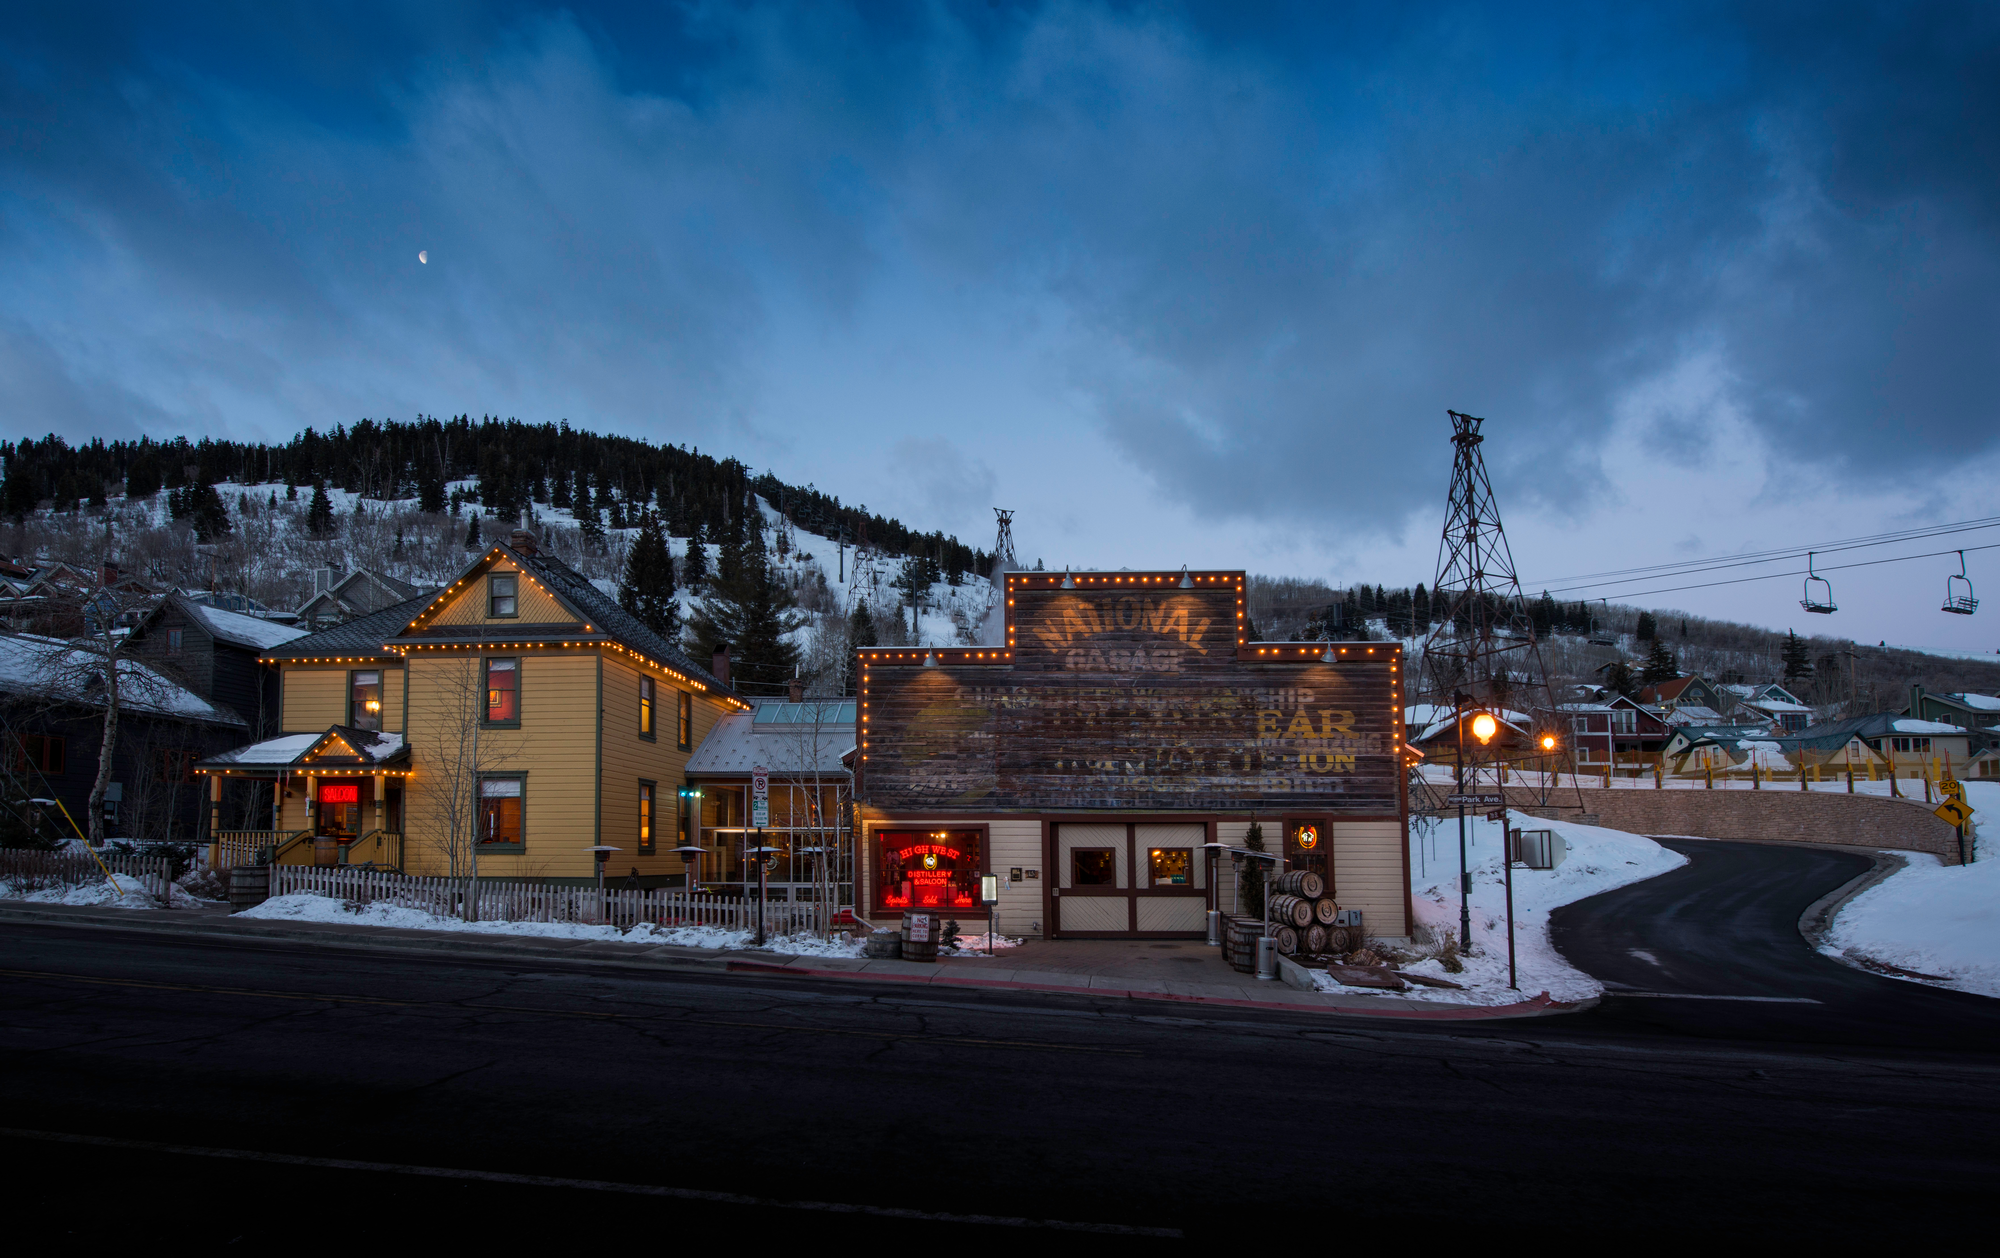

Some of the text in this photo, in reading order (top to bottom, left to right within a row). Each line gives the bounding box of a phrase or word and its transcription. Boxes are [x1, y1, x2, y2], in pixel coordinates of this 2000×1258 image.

[1032, 597, 1212, 655] NATIONAL
[1065, 649, 1186, 671] GARAGE
[1941, 782, 1957, 790] 20
[324, 788, 356, 800] SALOON
[900, 845, 960, 859] HIGH WEST
[886, 895, 972, 905] Spirits Sold Here
